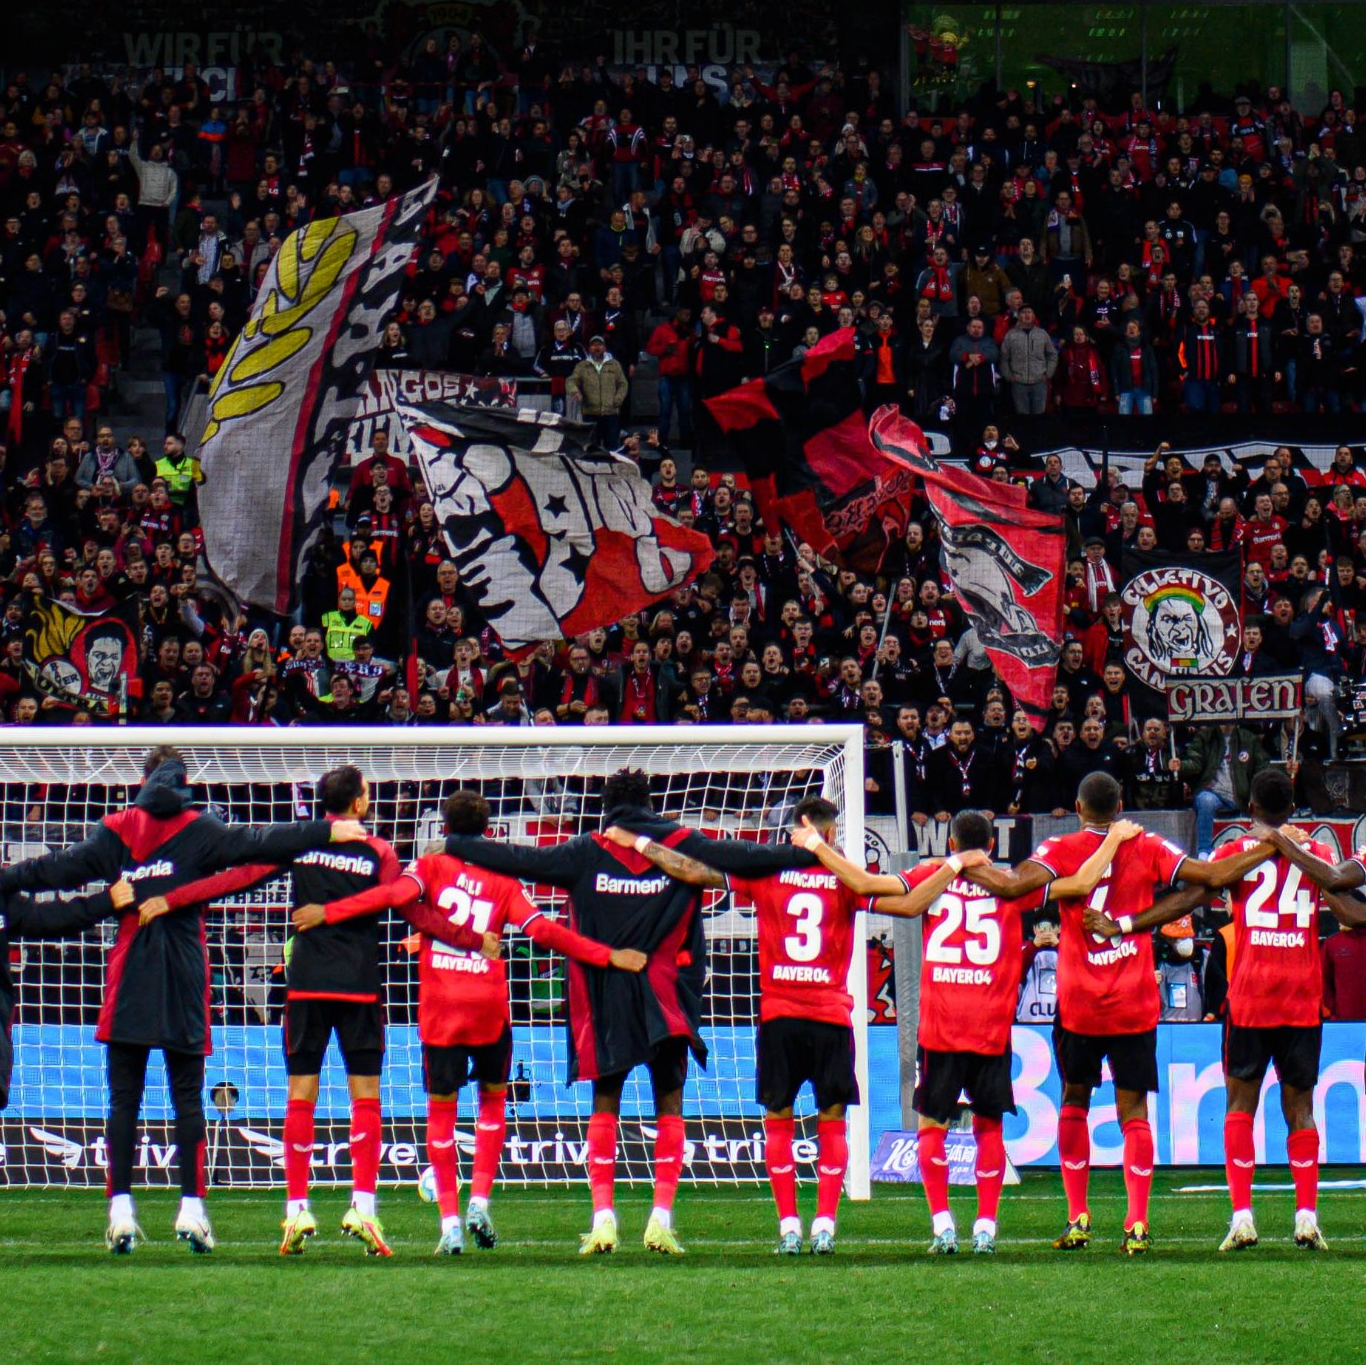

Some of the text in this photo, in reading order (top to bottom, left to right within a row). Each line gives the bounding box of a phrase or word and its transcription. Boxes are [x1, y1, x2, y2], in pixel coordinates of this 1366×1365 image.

[595, 873, 671, 895] Barmeni
[1243, 859, 1316, 930] 24
[784, 893, 825, 964] 3
[925, 893, 1003, 967] 25
[1250, 931, 1305, 948] BAYER04
[431, 953, 489, 975] BAYER04
[772, 964, 831, 984] BAYER04
[932, 966, 993, 986] BAYER04
